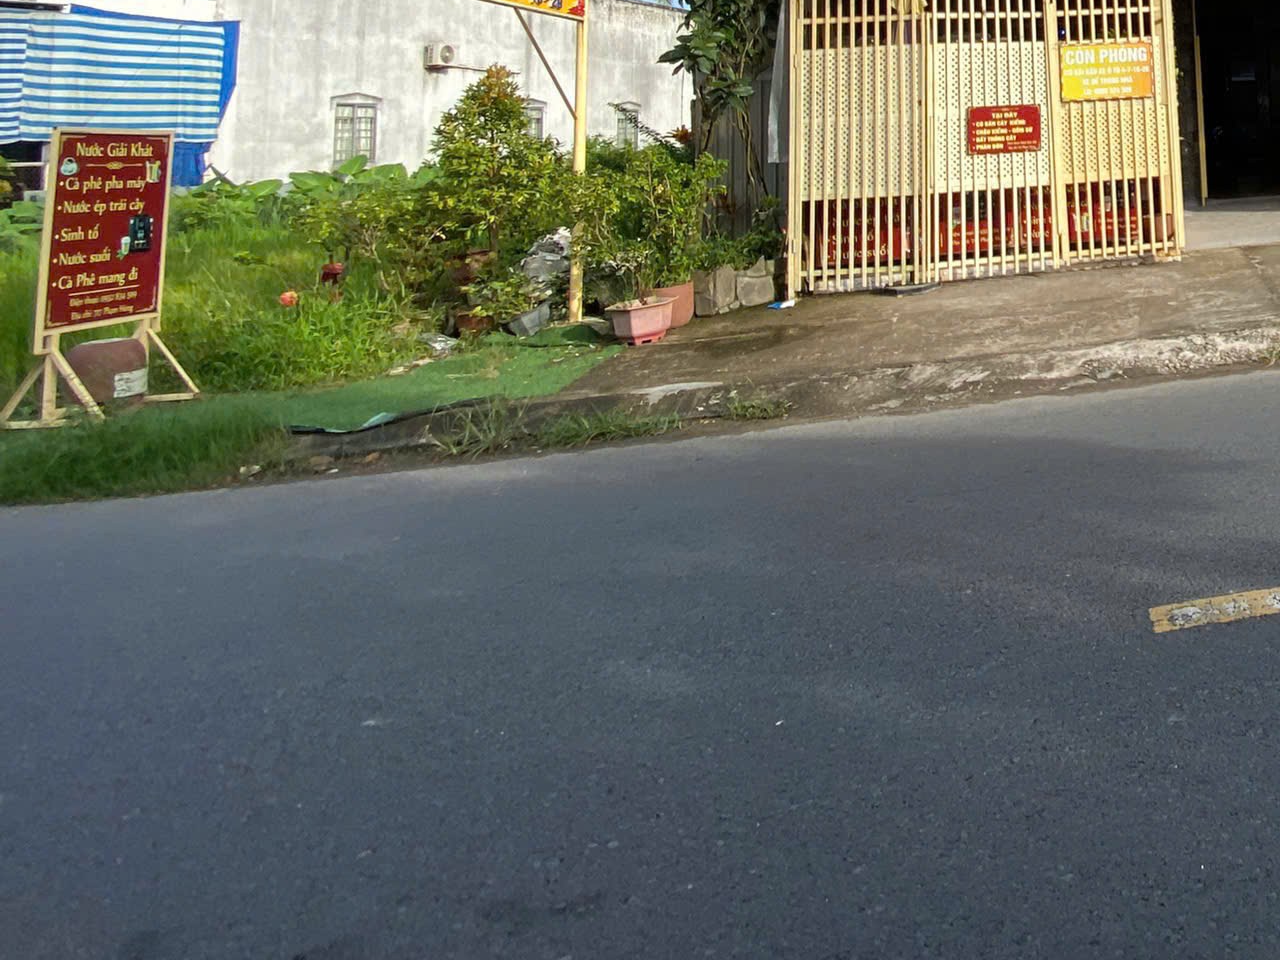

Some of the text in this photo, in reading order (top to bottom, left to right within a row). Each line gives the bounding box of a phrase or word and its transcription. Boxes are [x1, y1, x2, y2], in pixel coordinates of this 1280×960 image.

[76, 141, 153, 157] Nước Giải Khát
[65, 175, 148, 194] Cà phê pha máy
[63, 197, 145, 216] Nước ép trái cây
[60, 223, 100, 242] Sinh tố
[59, 246, 111, 266] Nước suối
[58, 266, 138, 289] Cà Phê mang đi
